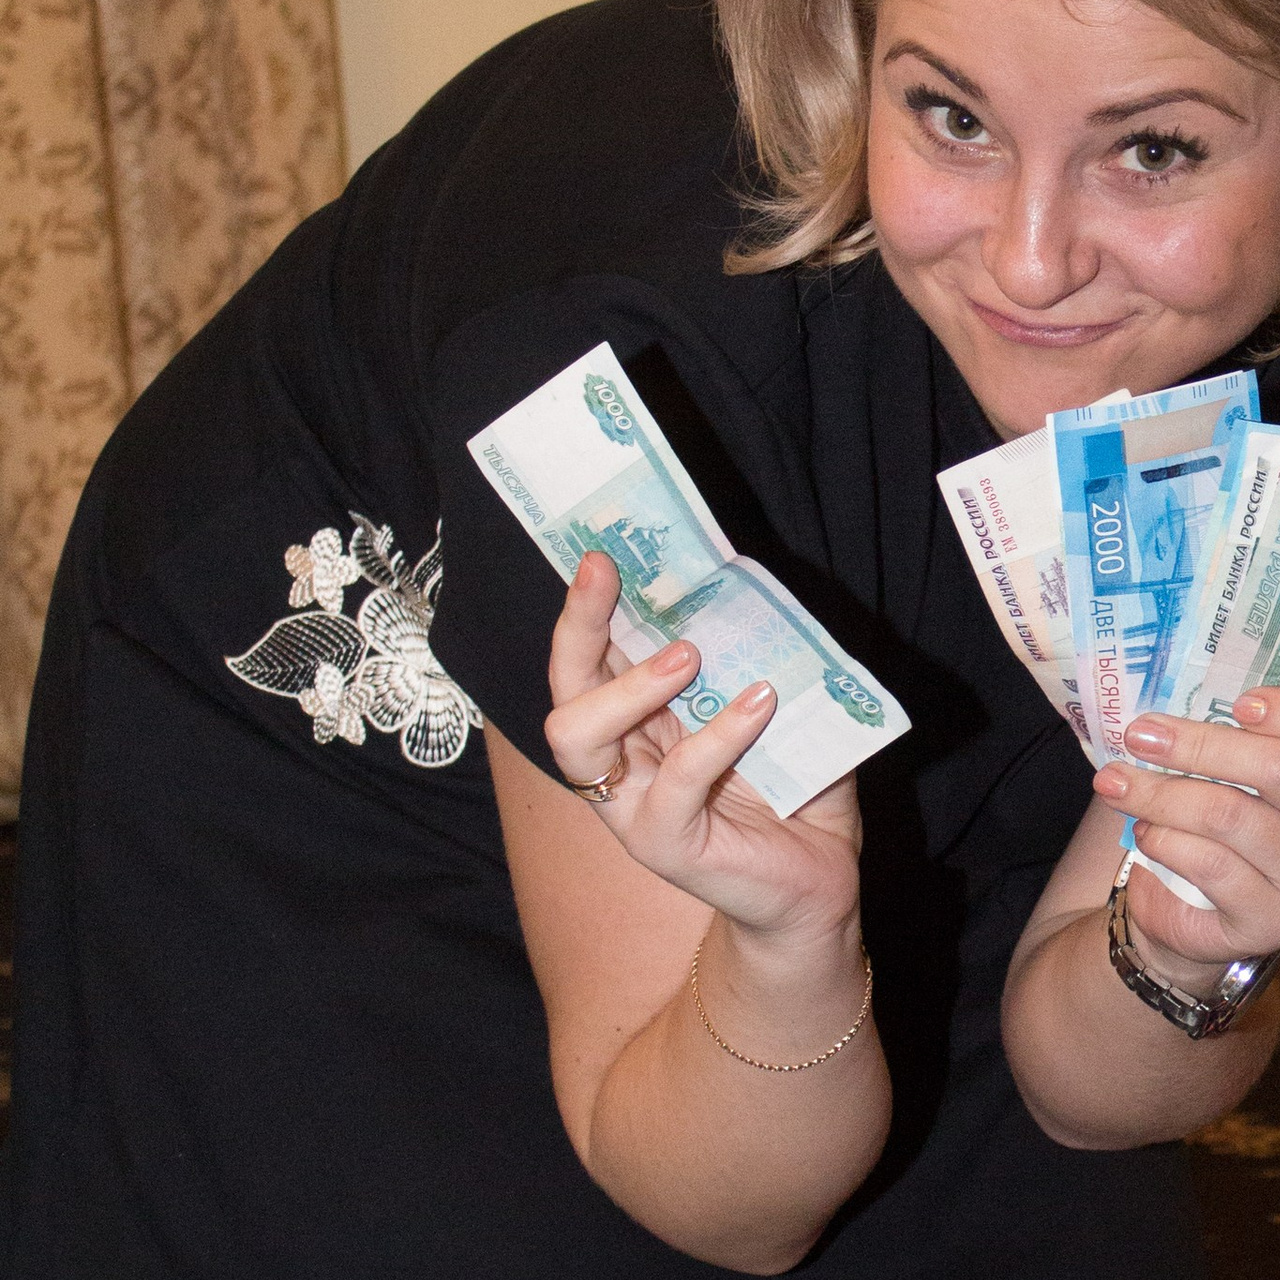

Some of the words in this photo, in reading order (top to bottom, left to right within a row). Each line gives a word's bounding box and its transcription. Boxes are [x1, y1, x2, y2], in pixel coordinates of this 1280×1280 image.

[594, 380, 633, 431] 1000
[483, 443, 547, 527] ТЫСЯЧА
[542, 529, 581, 575] РУБ
[962, 496, 1000, 560] РОССИИ
[979, 477, 1011, 532] 3890693
[1091, 500, 1126, 575] 2000
[1205, 604, 1230, 655] БИЛЕТ
[1222, 544, 1250, 602] БАНКА
[1240, 469, 1268, 540] РОССИИ
[991, 562, 1026, 618] БАНКА
[1089, 599, 1117, 640] ДВЕ
[832, 673, 881, 714] 1000
[1097, 645, 1123, 725] ТЫСЯЧИ
